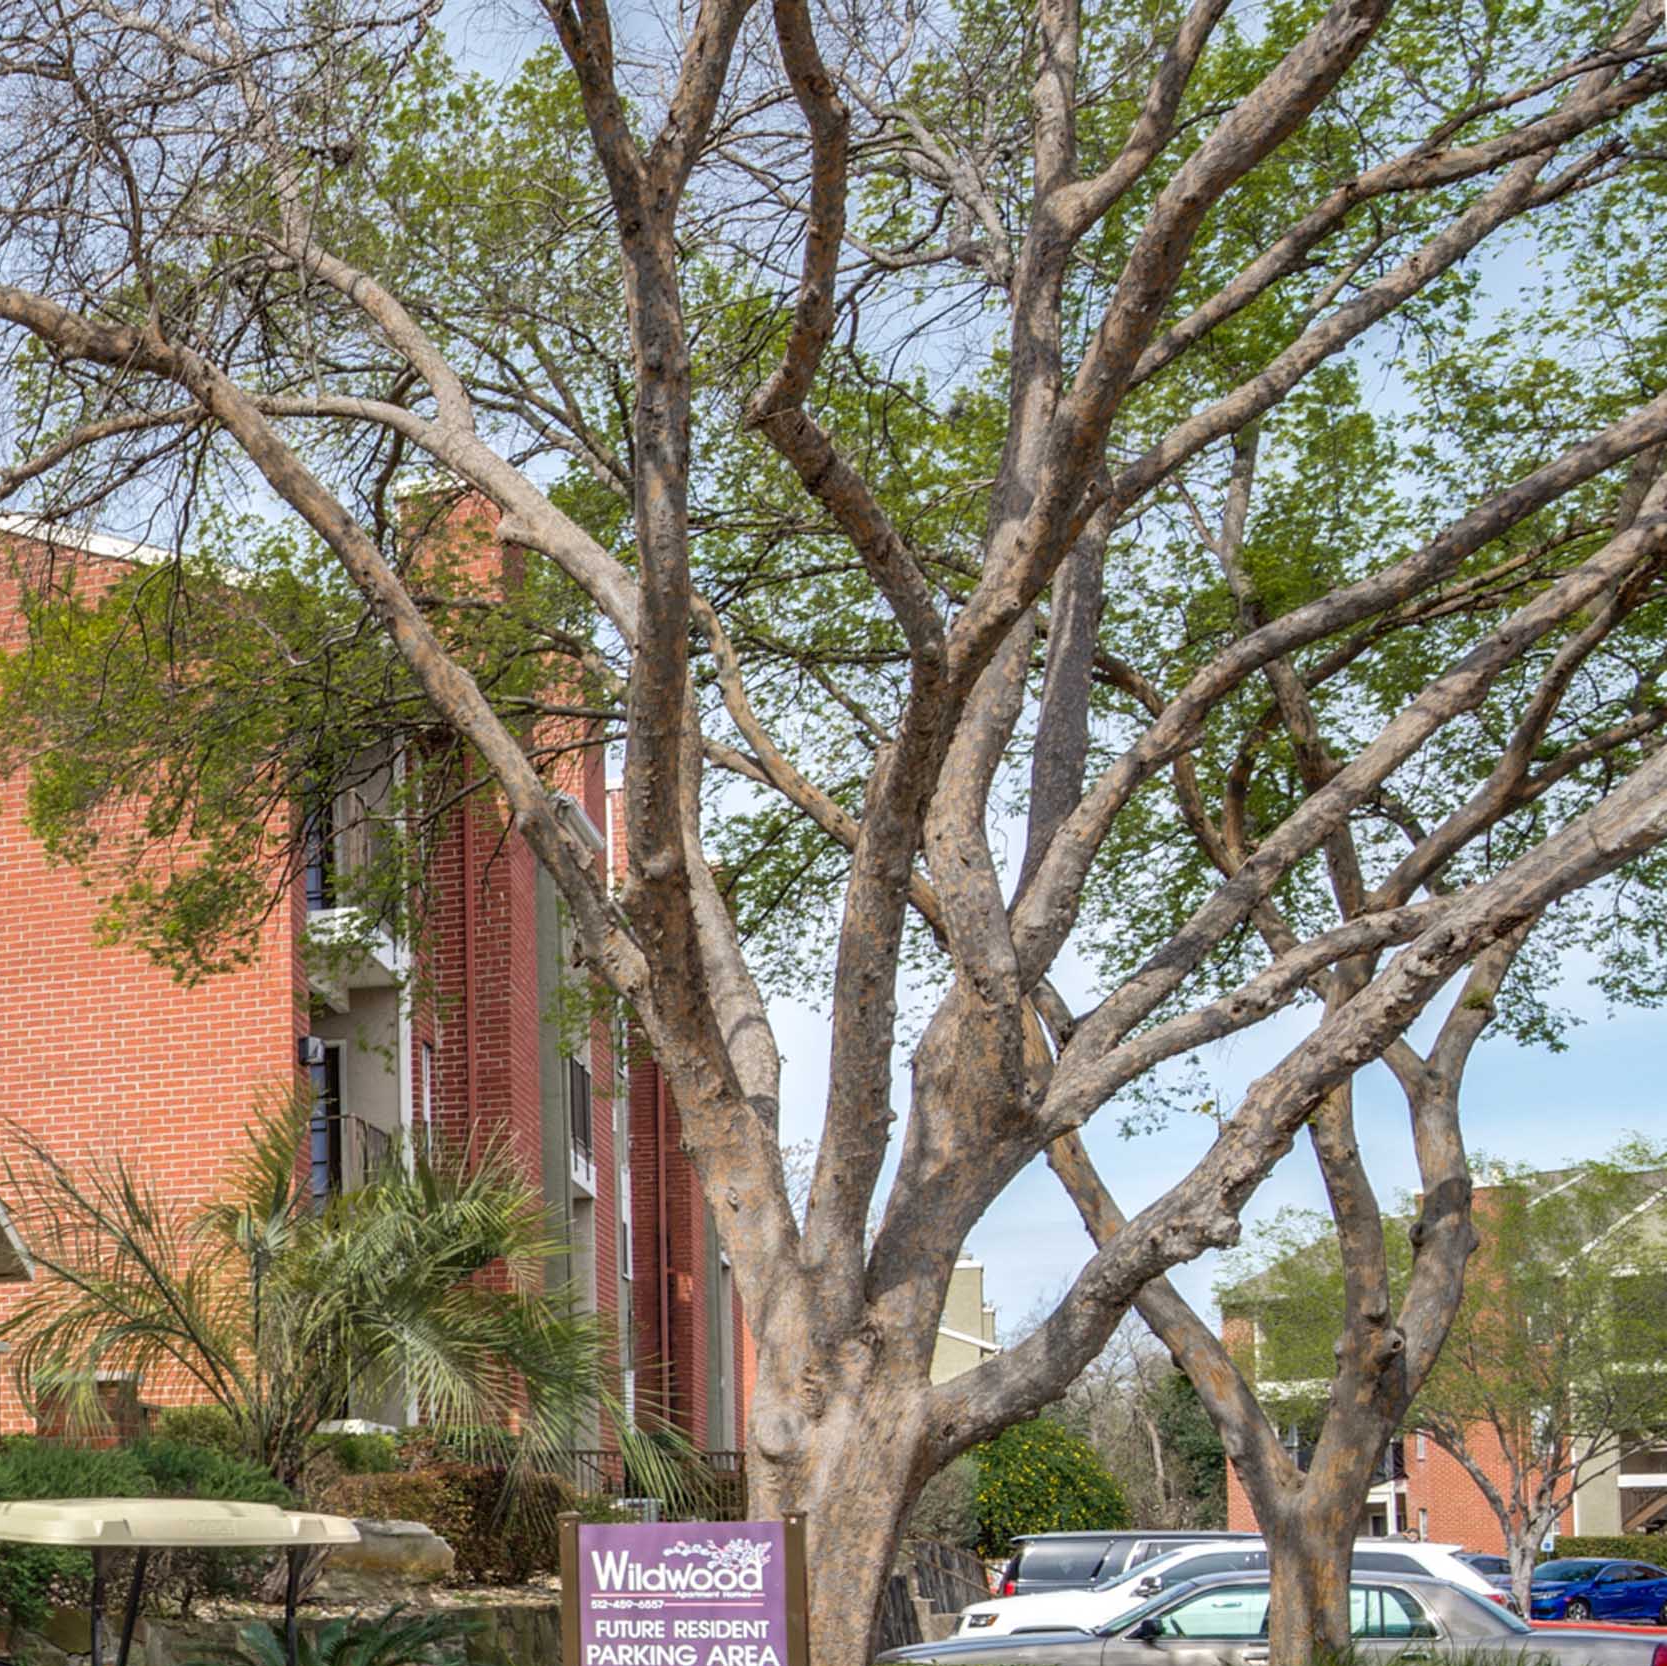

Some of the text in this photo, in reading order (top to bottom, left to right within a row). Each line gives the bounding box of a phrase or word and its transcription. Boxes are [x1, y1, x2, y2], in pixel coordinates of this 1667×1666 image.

[591, 1550, 763, 1592] Wildwood
[595, 1620, 770, 1640] FUTURE RESIDENT
[586, 1644, 698, 1666] PARKING
